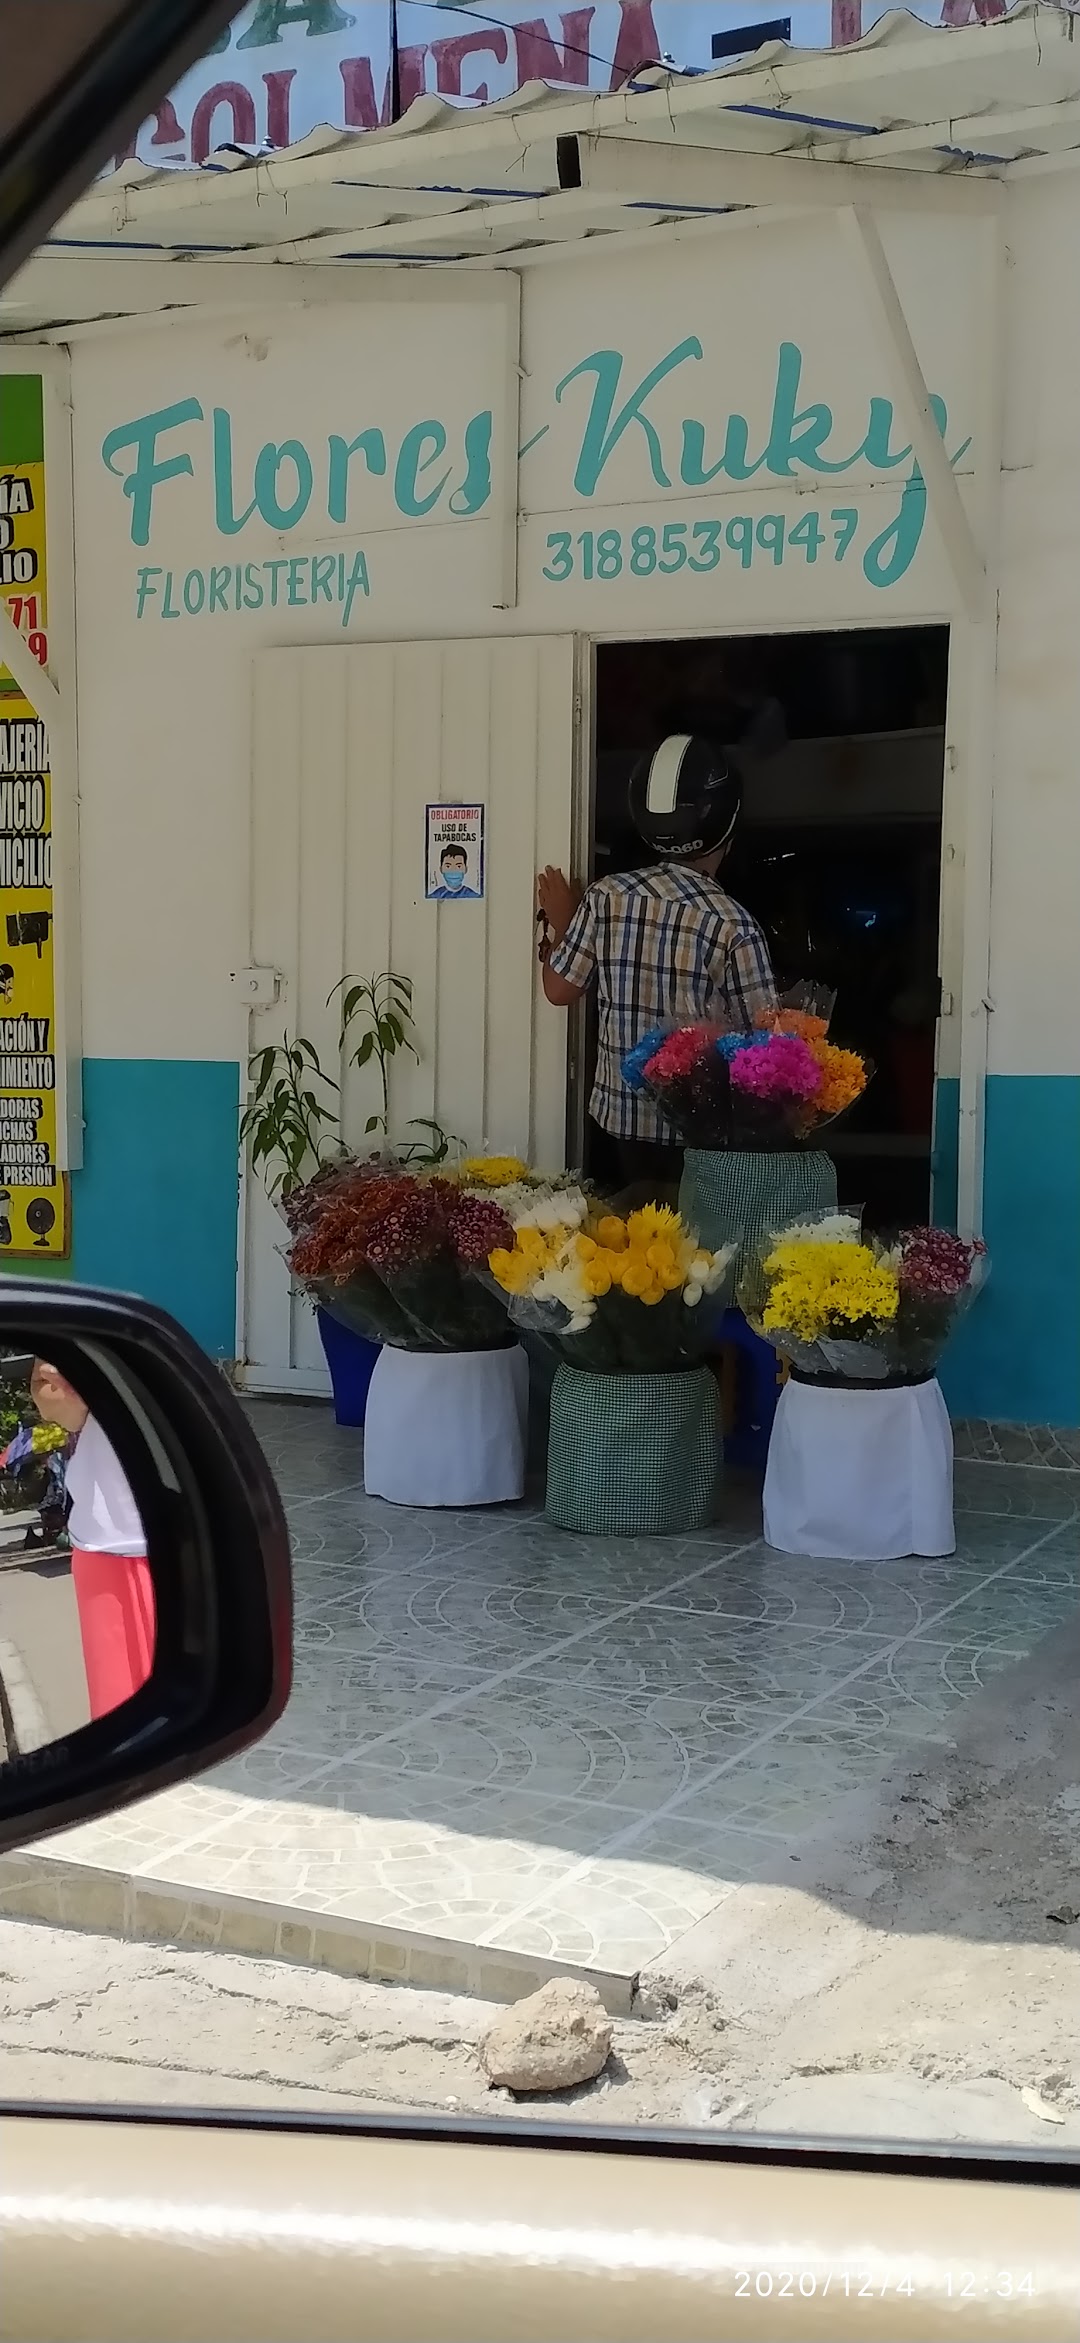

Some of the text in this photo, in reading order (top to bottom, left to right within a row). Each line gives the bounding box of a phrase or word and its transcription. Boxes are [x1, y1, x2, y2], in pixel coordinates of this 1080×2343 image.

[102, 335, 973, 588] Flores Kuky
[542, 508, 859, 581] 3188539947
[137, 551, 371, 627] FLORISTERIA
[430, 809, 480, 820] OBLIGATORIO
[433, 832, 477, 842] TAPABOCAS
[441, 823, 468, 833] USO DE
[0, 1056, 53, 1088] IMIENTO
[0, 1120, 34, 1141] CHAS
